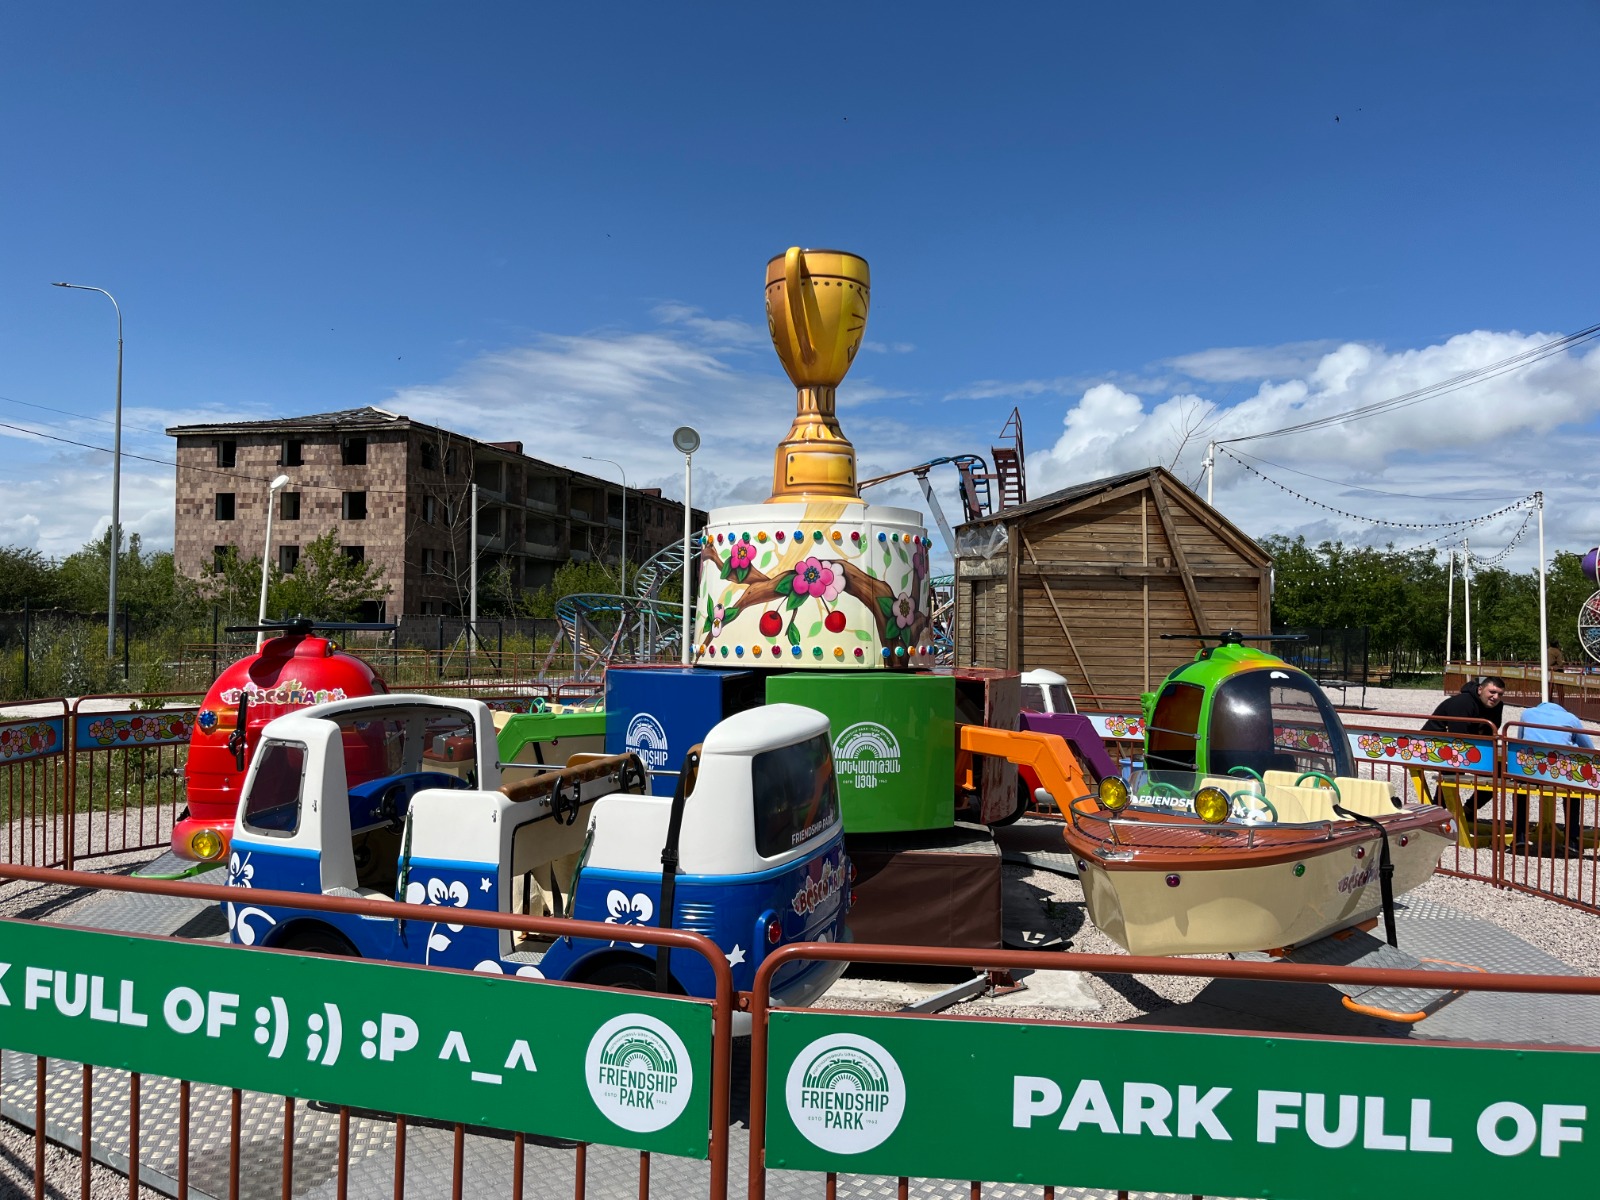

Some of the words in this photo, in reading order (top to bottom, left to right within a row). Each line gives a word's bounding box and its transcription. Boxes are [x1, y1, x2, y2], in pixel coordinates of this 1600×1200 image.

[836, 760, 900, 774] ԱՐԵԿԱՄՈՒԹՅԱՆ
[1139, 795, 1195, 808] FRIENDSH
[791, 820, 822, 845] FRIENDSHIP
[25, 966, 147, 1026] FULL
[164, 987, 239, 1038] OF
[255, 997, 289, 1059] :)
[307, 1003, 342, 1066] ;)
[361, 1013, 418, 1061] :P
[599, 1066, 678, 1094] FRIENDSHIP
[619, 1088, 654, 1110] PARK
[801, 1090, 889, 1112] FRIENDSHIP
[824, 1111, 863, 1130] PARK
[1013, 1076, 1232, 1140] PARK
[1257, 1090, 1452, 1152] FULL
[1477, 1102, 1586, 1157] OF
